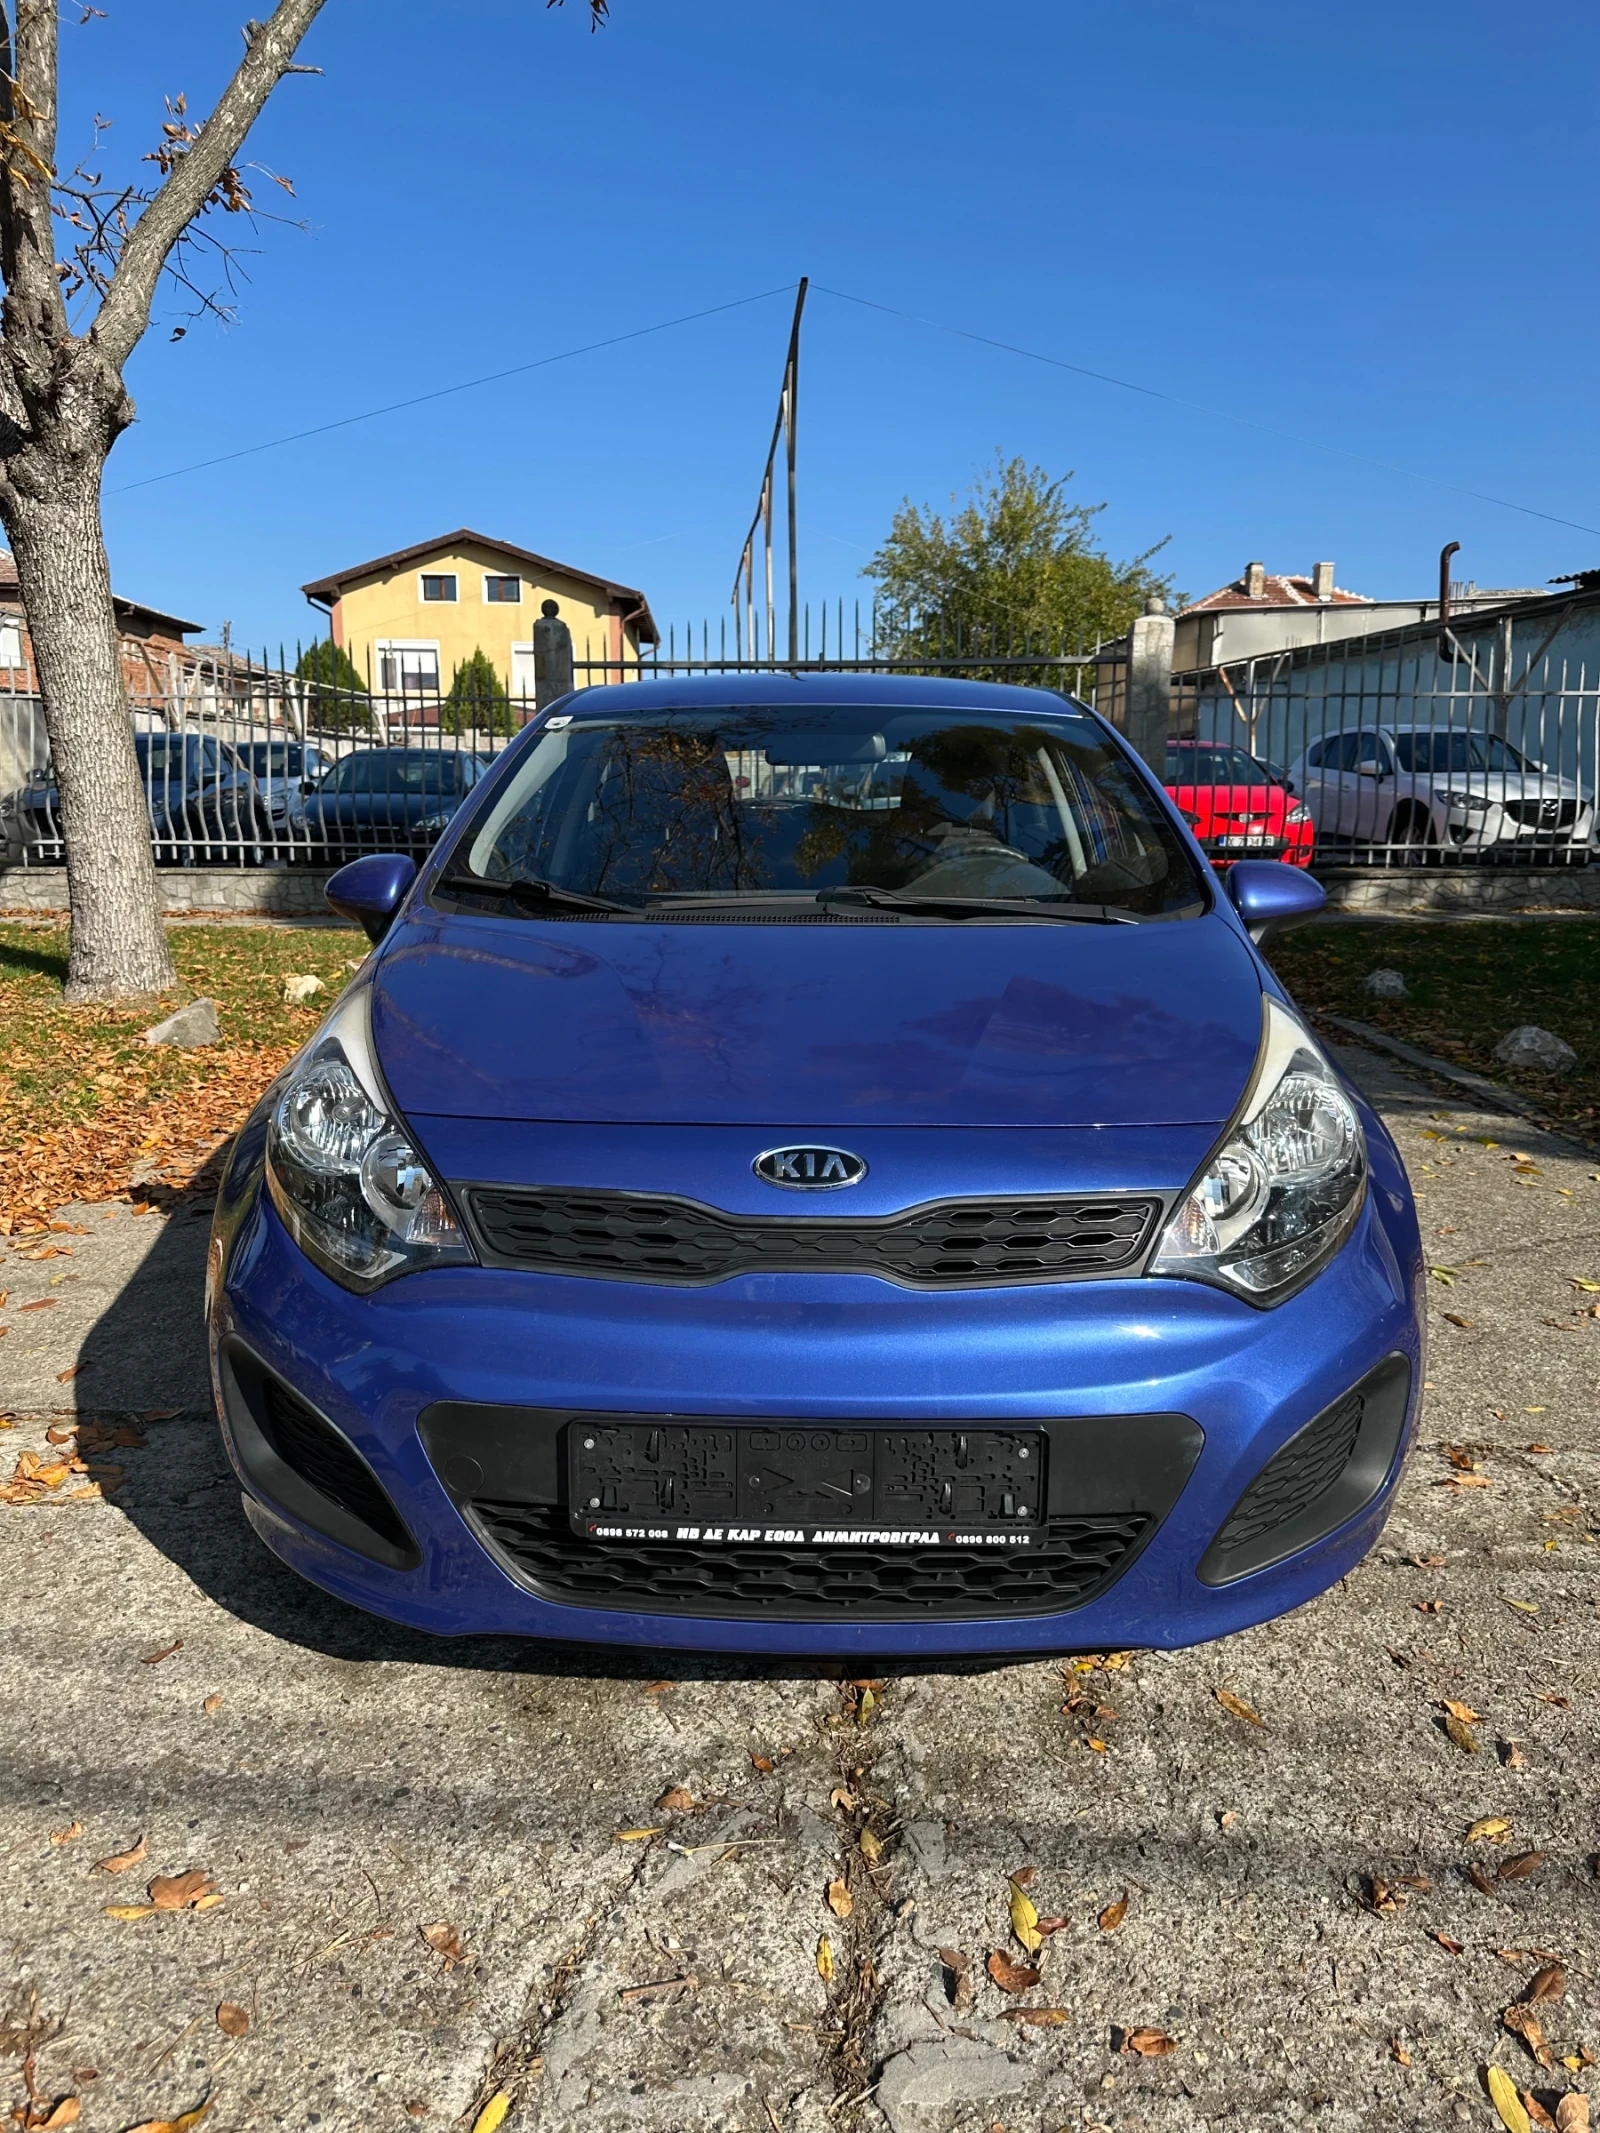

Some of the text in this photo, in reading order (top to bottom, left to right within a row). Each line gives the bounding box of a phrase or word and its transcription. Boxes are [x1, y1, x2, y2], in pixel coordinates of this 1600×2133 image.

[773, 1153, 848, 1178] KIA
[596, 1527, 623, 1537] 0898
[625, 1528, 646, 1538] 572
[648, 1529, 669, 1539] 008
[702, 1528, 724, 1540] ДЕ
[727, 1529, 761, 1541] КАР
[764, 1530, 805, 1542] ЕООД
[812, 1531, 940, 1543] ДИМИТРОВГРАД
[955, 1535, 983, 1544] 0896
[985, 1535, 1006, 1544] 800
[1009, 1535, 1030, 1544] 512
